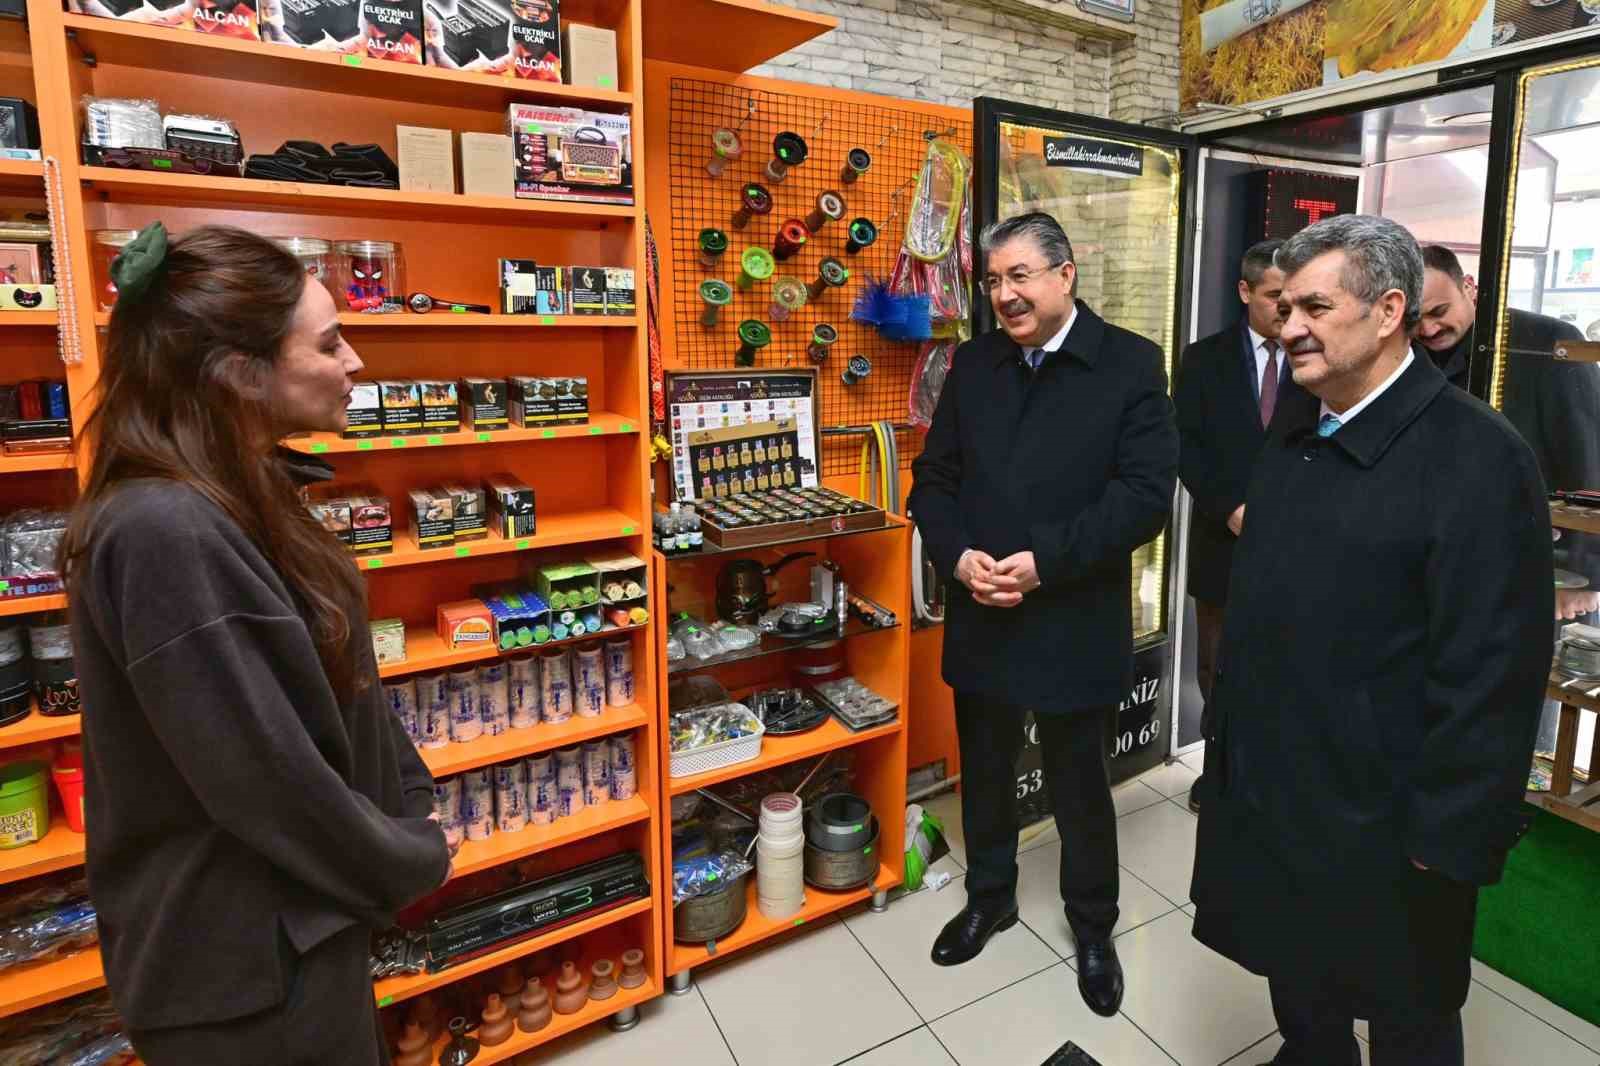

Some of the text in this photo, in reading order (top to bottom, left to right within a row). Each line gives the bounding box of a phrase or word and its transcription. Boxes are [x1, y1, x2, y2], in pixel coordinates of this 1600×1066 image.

[192, 7, 249, 27] ALCAN
[364, 4, 414, 20] ELEKTRİKLİ
[377, 14, 402, 25] OCAK
[513, 25, 555, 40] ELEKTRİKLİ
[524, 34, 545, 45] OCAK
[367, 37, 415, 55] ALCAN
[515, 56, 554, 72] ALCAN
[1120, 677, 1159, 711] NİZ
[1139, 719, 1160, 745] 69
